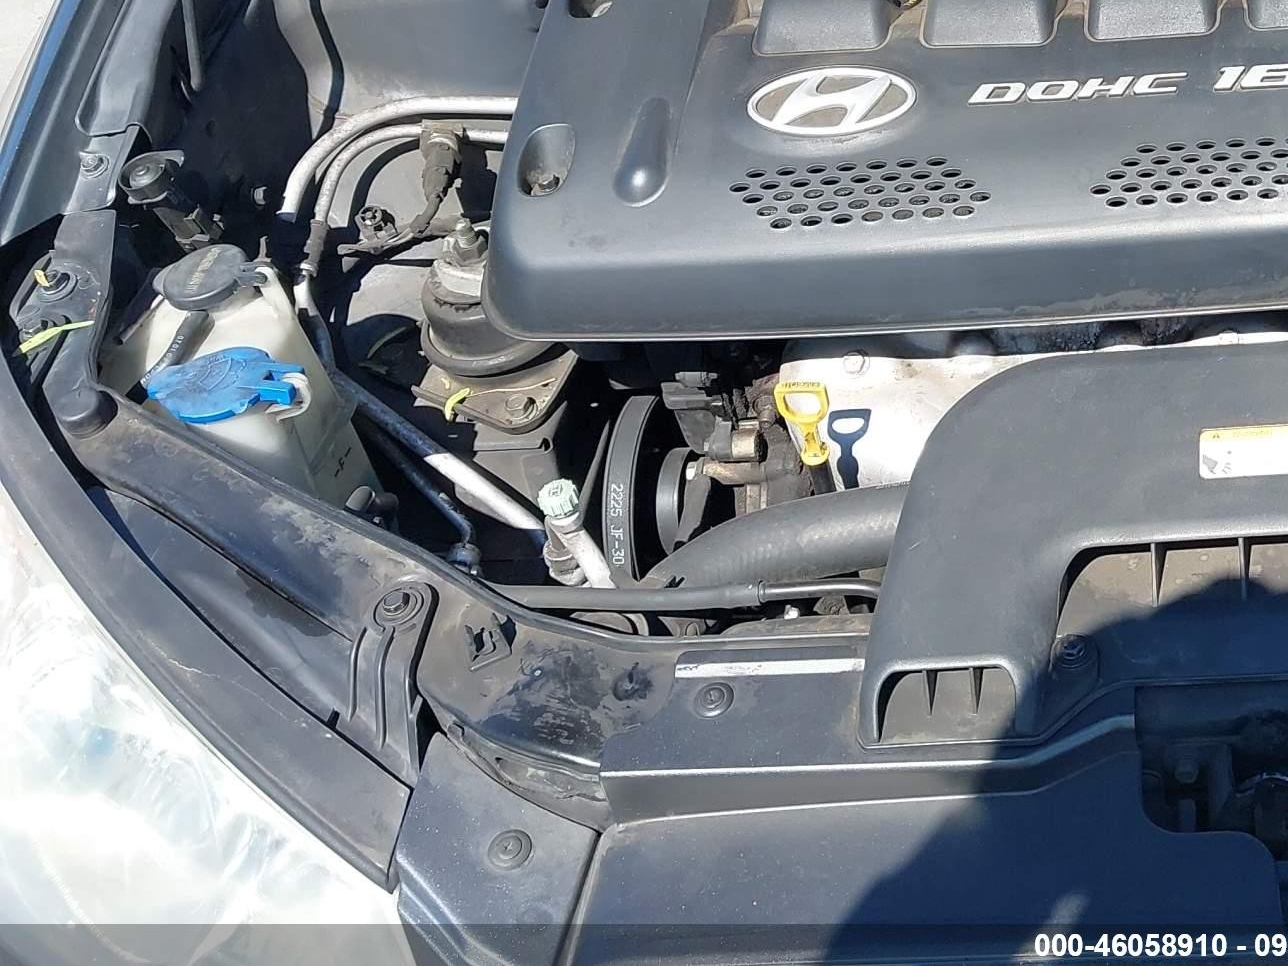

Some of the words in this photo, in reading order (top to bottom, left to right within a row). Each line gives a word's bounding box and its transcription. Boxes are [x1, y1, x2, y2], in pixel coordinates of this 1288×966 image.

[967, 72, 1188, 106] DOHC
[610, 483, 625, 517] 2225
[610, 524, 625, 565] JF-30
